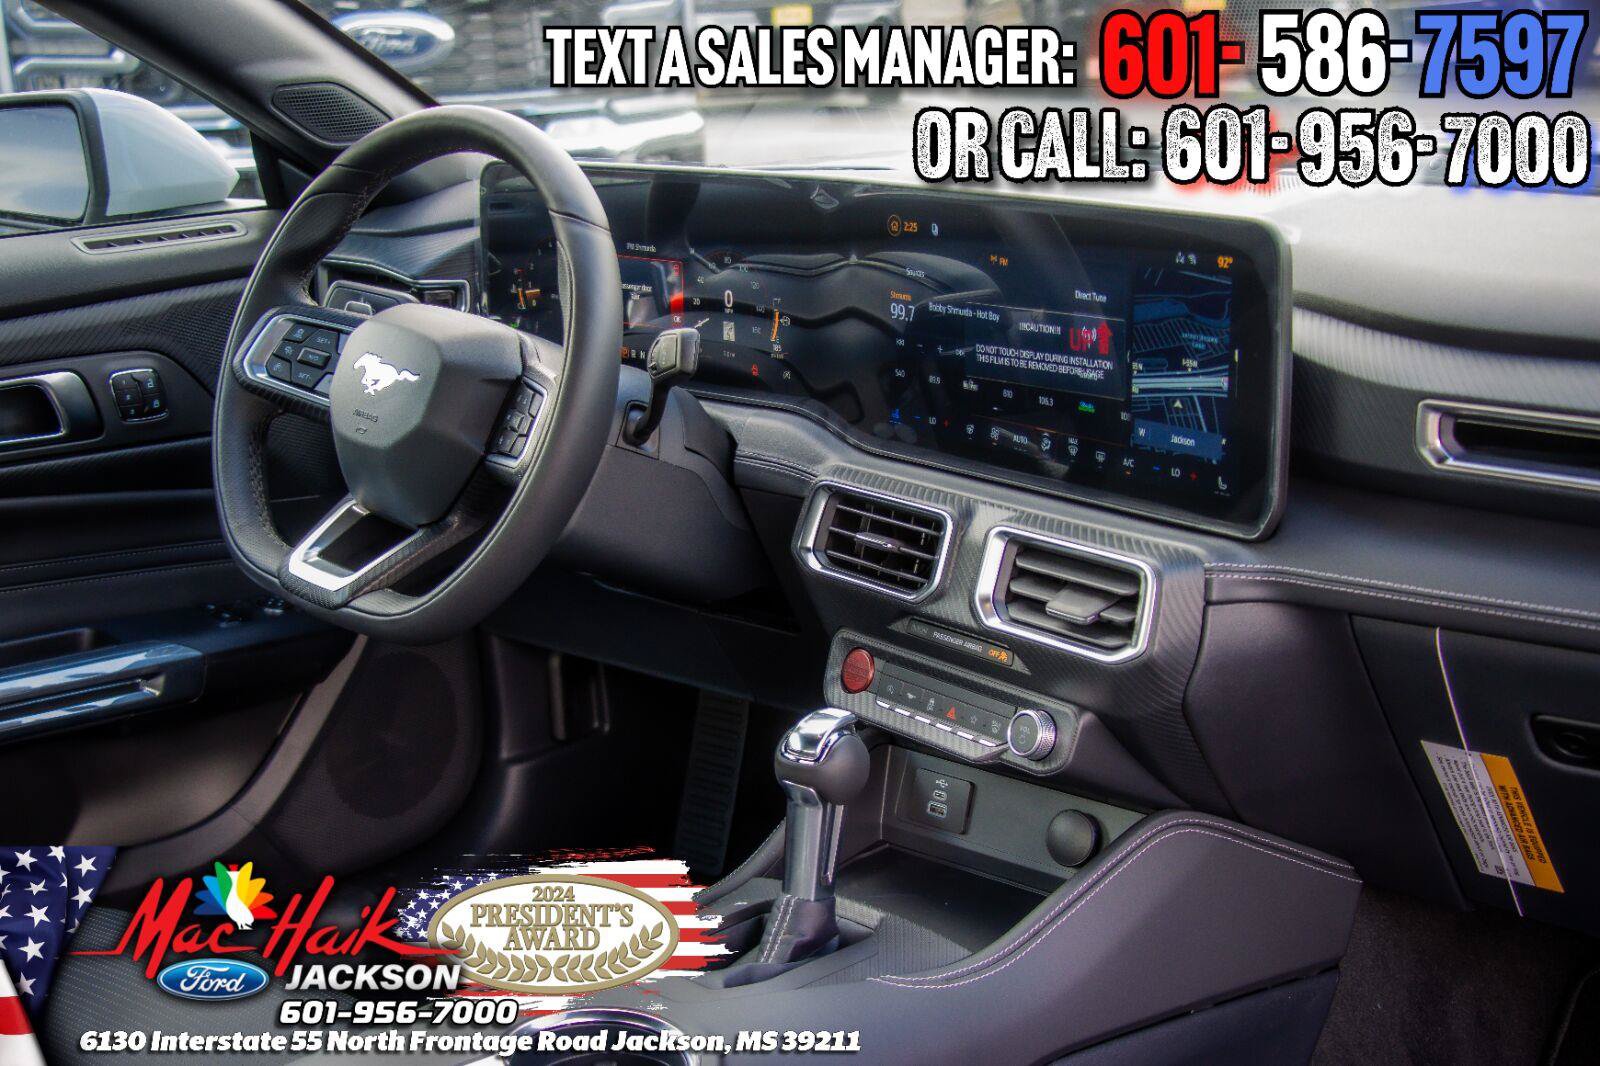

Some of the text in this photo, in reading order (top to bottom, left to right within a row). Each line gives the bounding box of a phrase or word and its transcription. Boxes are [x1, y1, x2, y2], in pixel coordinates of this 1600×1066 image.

[903, 222, 918, 232] 2:25
[1075, 290, 1091, 301] Direct
[890, 303, 915, 322] 99.7
[928, 302, 946, 314] Bobby
[947, 305, 973, 317] Shmurda
[977, 310, 988, 320] Hot
[989, 311, 1000, 323] Boy
[975, 344, 1113, 370] DO NOT TOUCH DISPLAY DURING INSTALLATION
[976, 353, 989, 363] THIS
[1011, 358, 1019, 367] TO
[1020, 359, 1027, 369] BE
[1028, 361, 1058, 374] REMOVED
[1138, 427, 1196, 448] W Jackson
[1122, 457, 1135, 469] A/C
[1171, 467, 1180, 478] LO
[932, 631, 1000, 658] PASSENGER AIRBAG OFF
